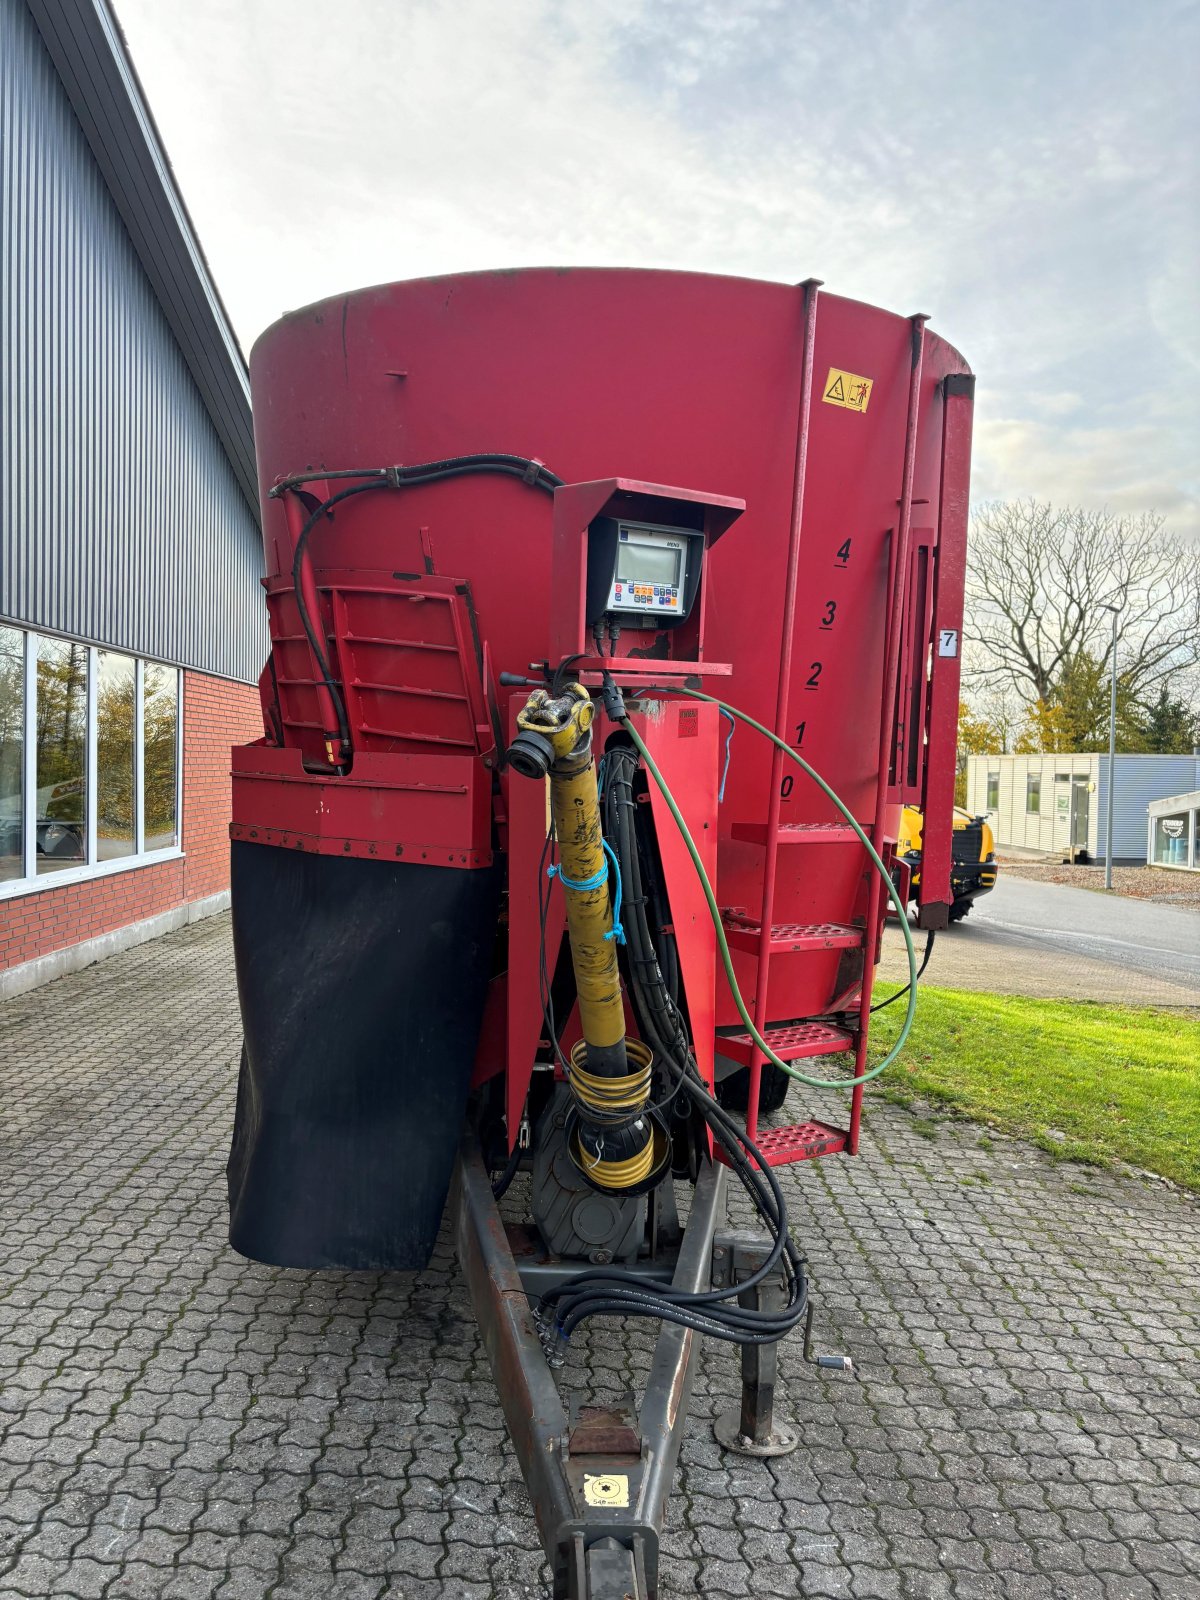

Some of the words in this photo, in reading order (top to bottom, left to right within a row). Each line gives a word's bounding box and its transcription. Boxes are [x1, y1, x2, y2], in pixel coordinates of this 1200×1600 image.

[837, 538, 852, 563] 4
[821, 600, 837, 626] 3
[943, 632, 954, 646] 7
[806, 661, 823, 686] 2
[795, 721, 807, 744] 1
[780, 775, 794, 798] 0
